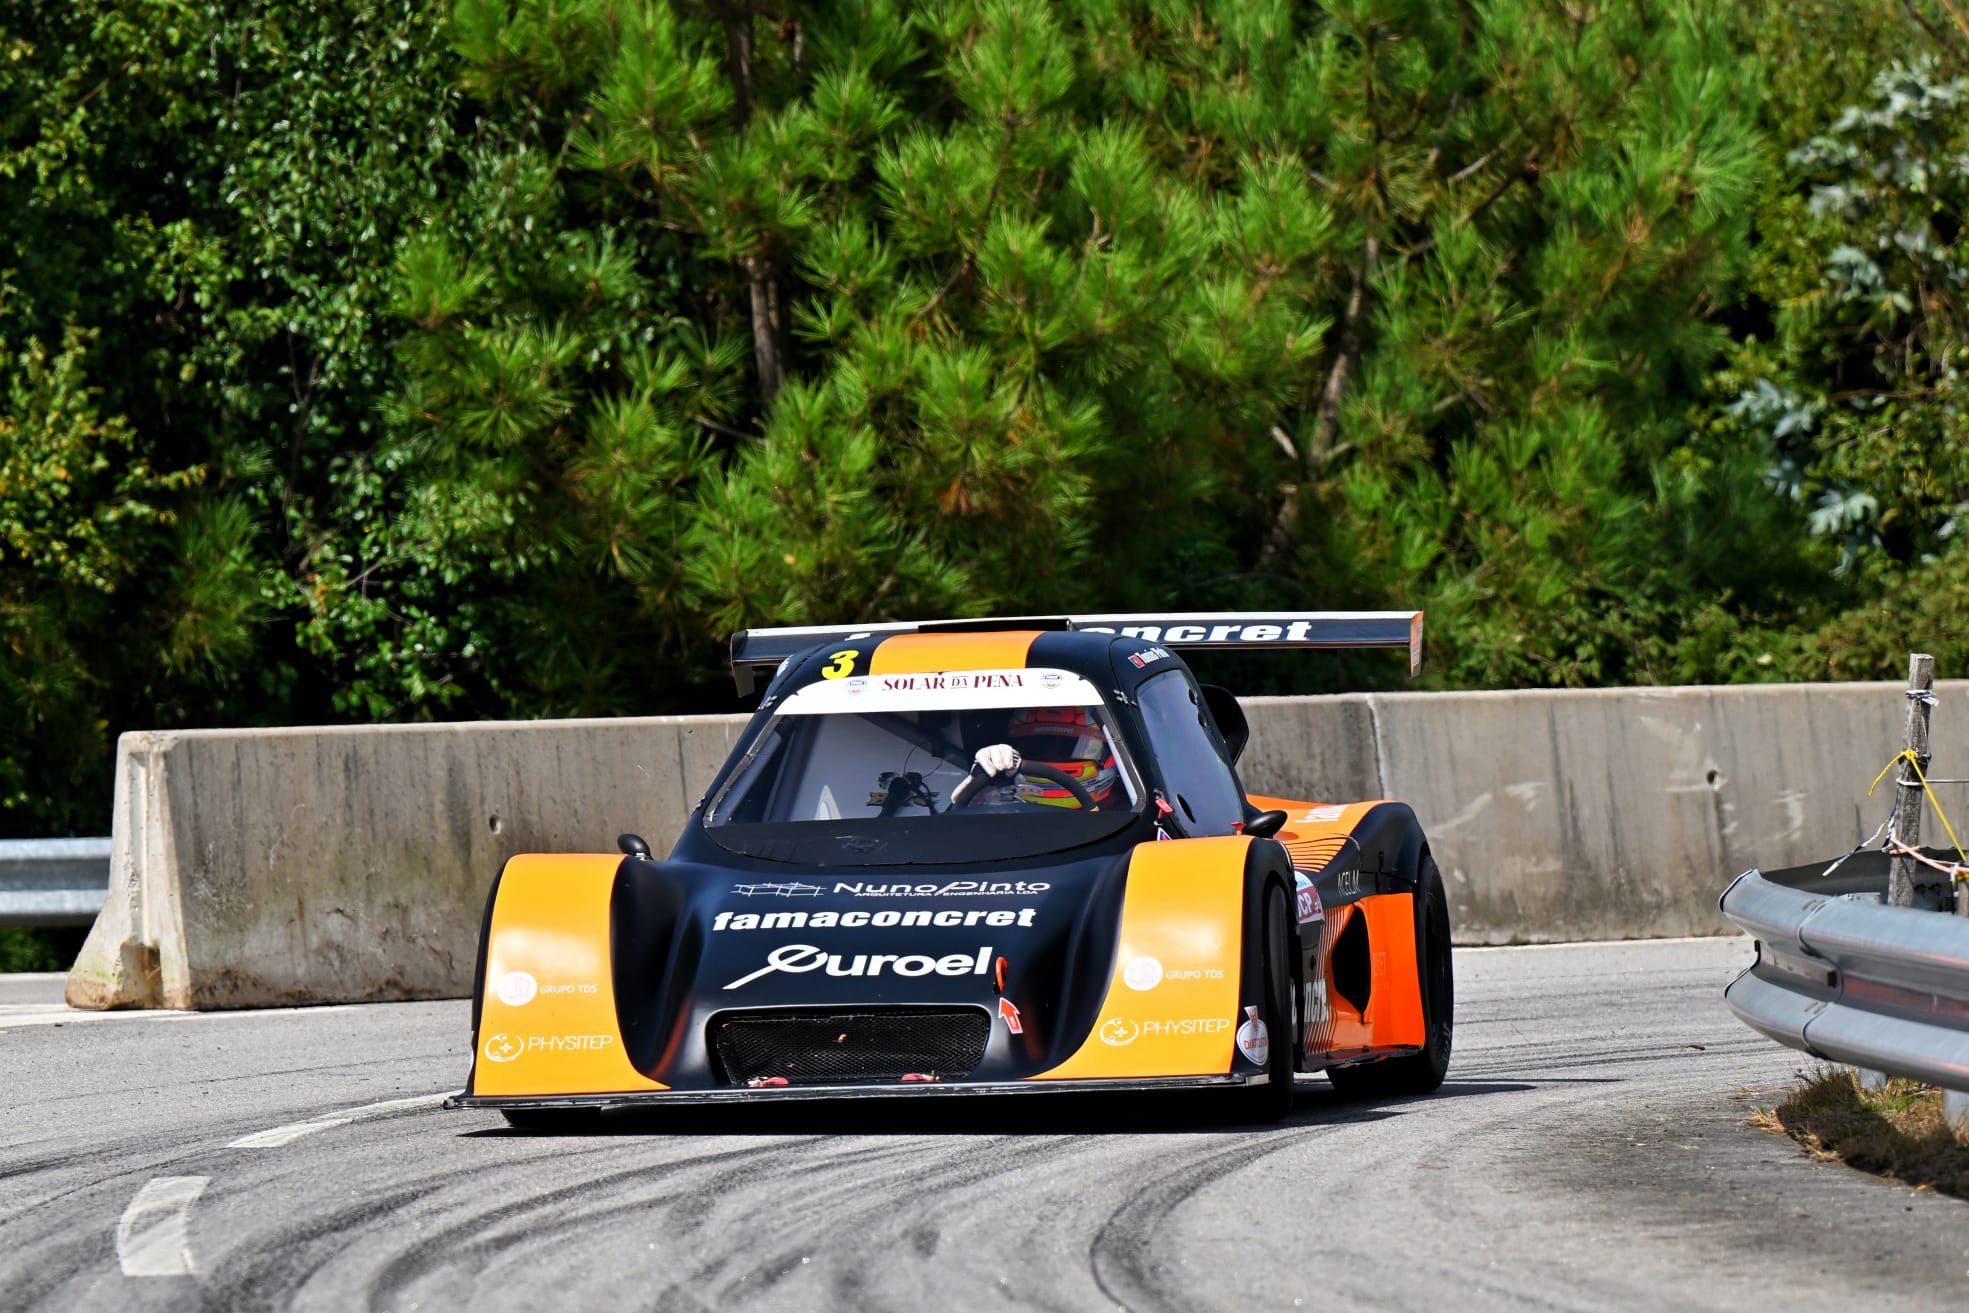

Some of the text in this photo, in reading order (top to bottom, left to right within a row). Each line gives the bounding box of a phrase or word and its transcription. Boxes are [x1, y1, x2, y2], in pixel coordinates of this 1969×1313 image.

[821, 650, 860, 680] 3
[882, 674, 1024, 692] SOLAR DA PENA
[712, 908, 1037, 931] famaconcret
[722, 945, 993, 990] euroel
[1165, 969, 1224, 980] GRUPO TDS
[540, 984, 598, 994] GRUPO TDS
[1142, 1018, 1231, 1036] PHYSITEP
[527, 1034, 614, 1051] PHYSITEP
